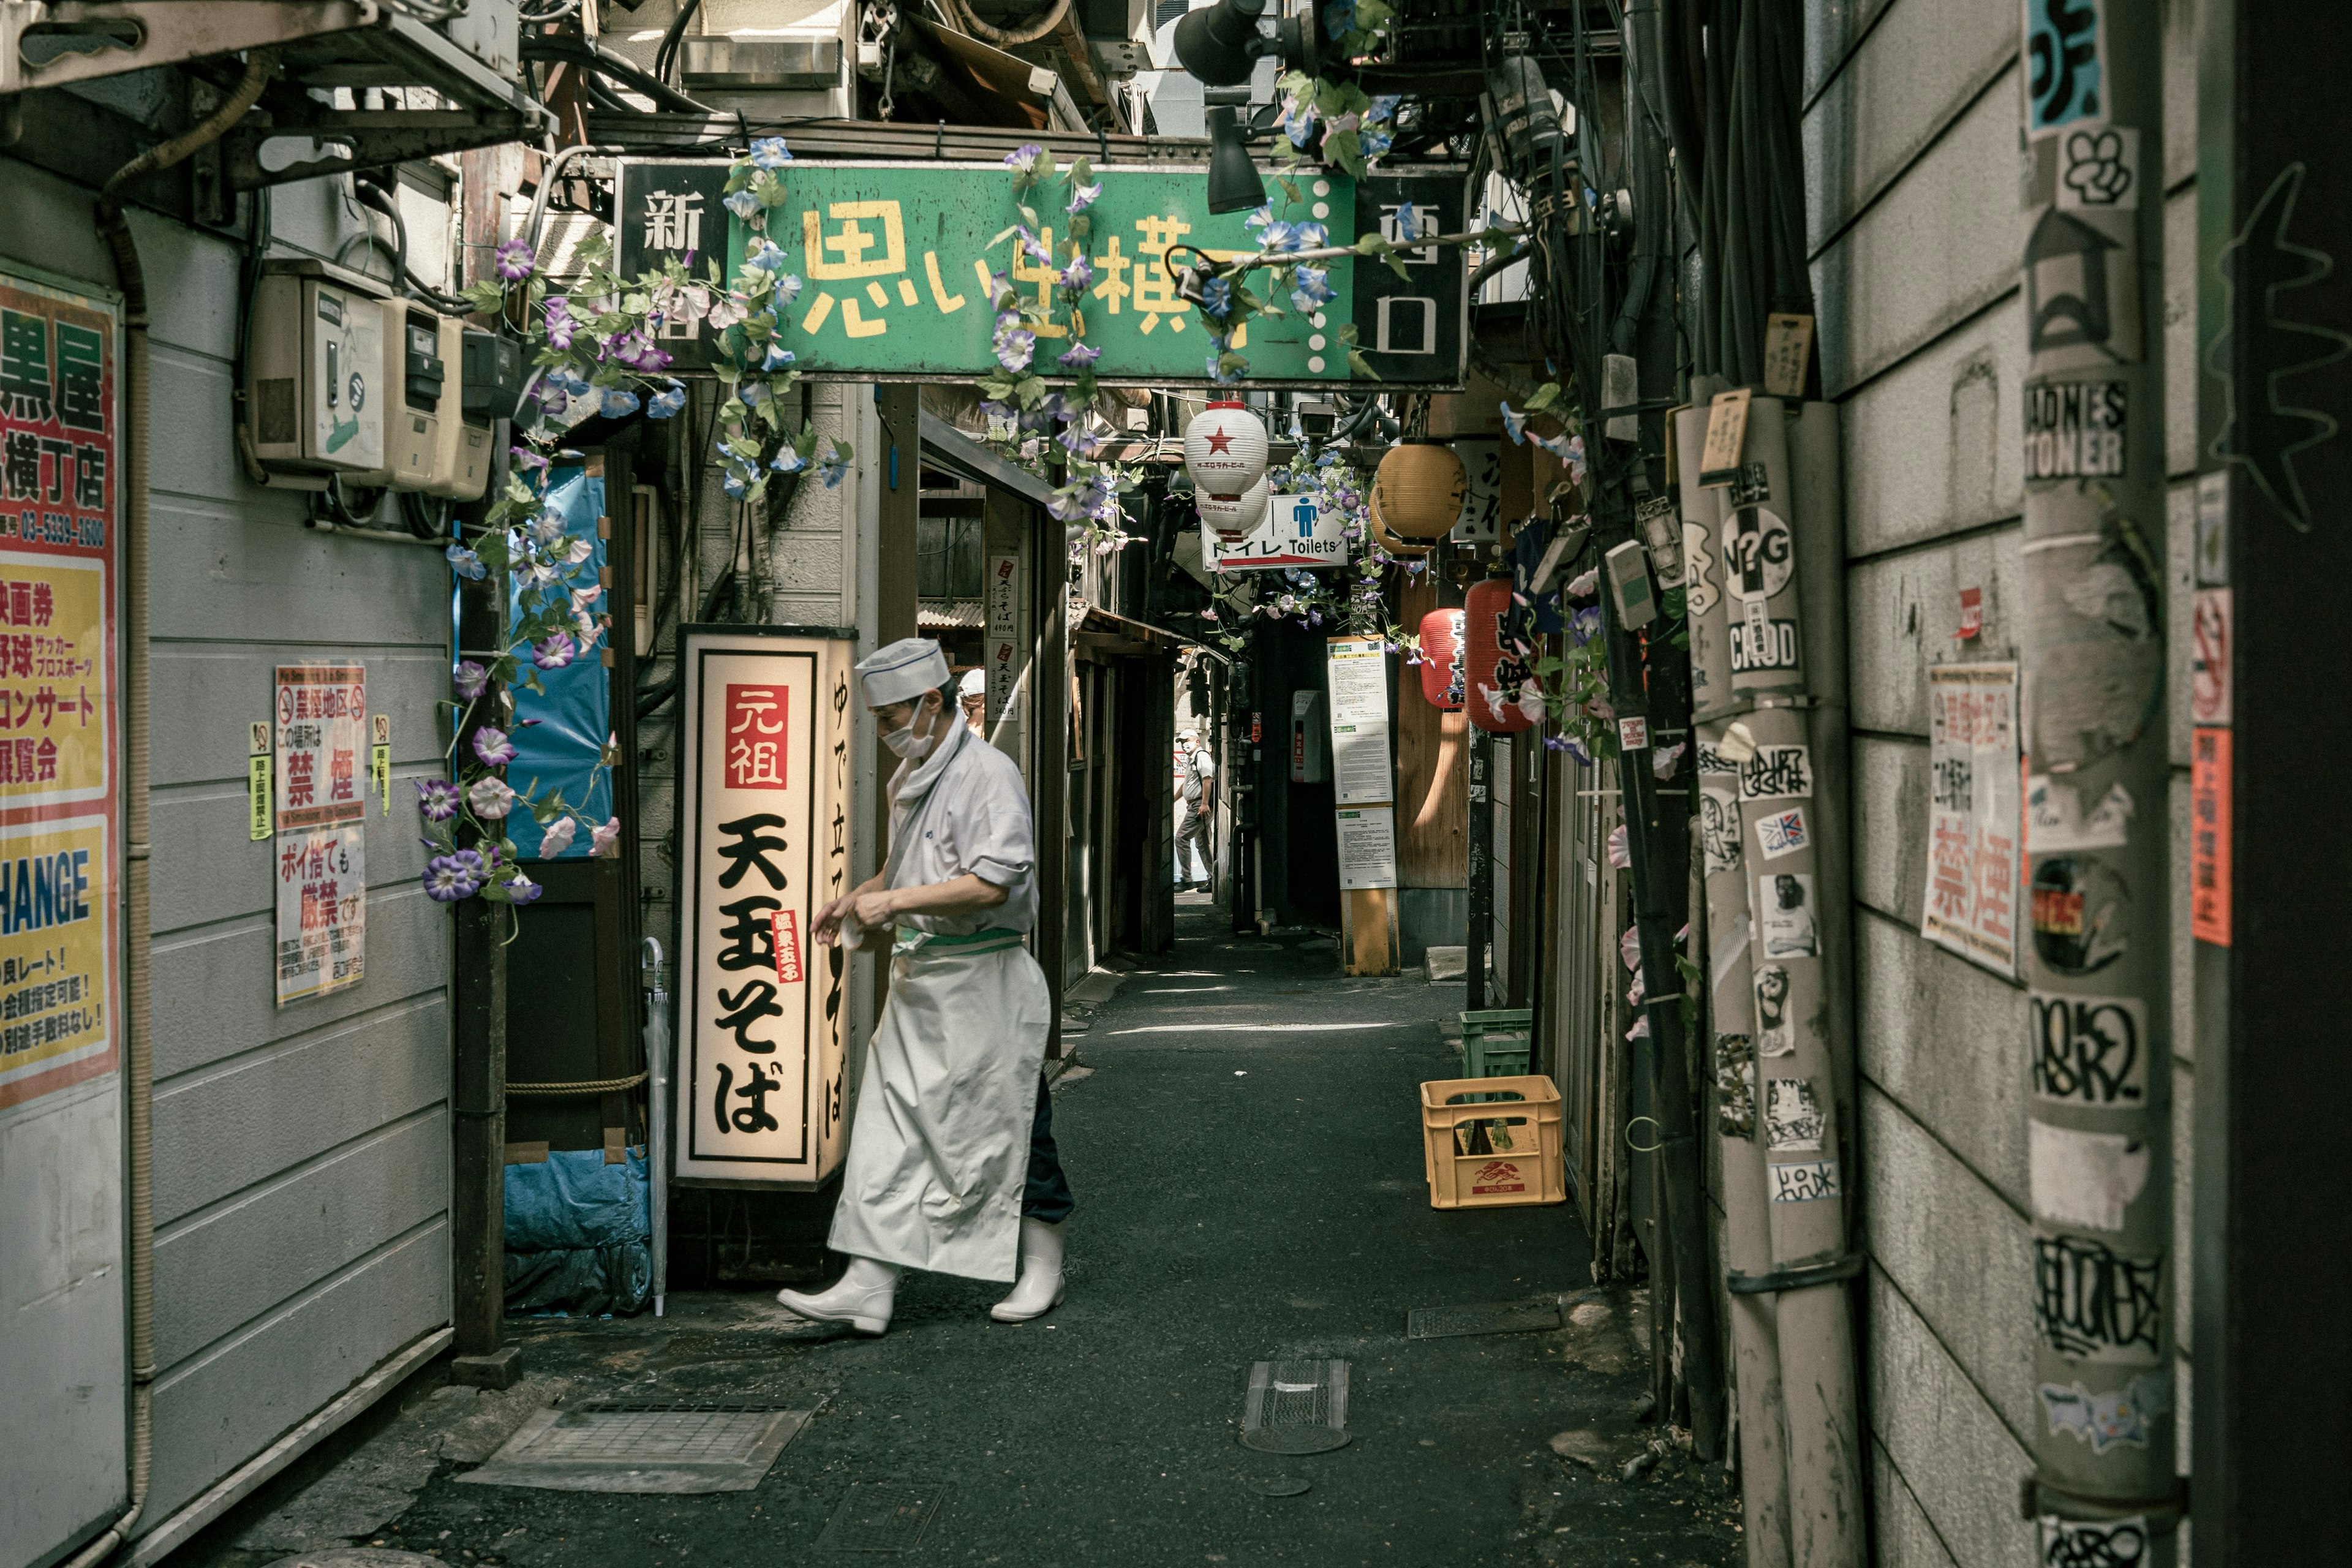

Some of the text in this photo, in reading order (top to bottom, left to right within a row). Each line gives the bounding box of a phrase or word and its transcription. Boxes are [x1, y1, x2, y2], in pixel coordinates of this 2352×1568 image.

[4, 428, 105, 511] 横丁店
[1213, 541, 1282, 557] トイレ
[1289, 538, 1336, 554] Toilets
[35, 635, 74, 655] サッカー
[0, 685, 93, 729] コンサート
[733, 691, 784, 785] 元祖
[288, 750, 354, 807] 禁煙
[715, 812, 789, 1136] 天玉そば
